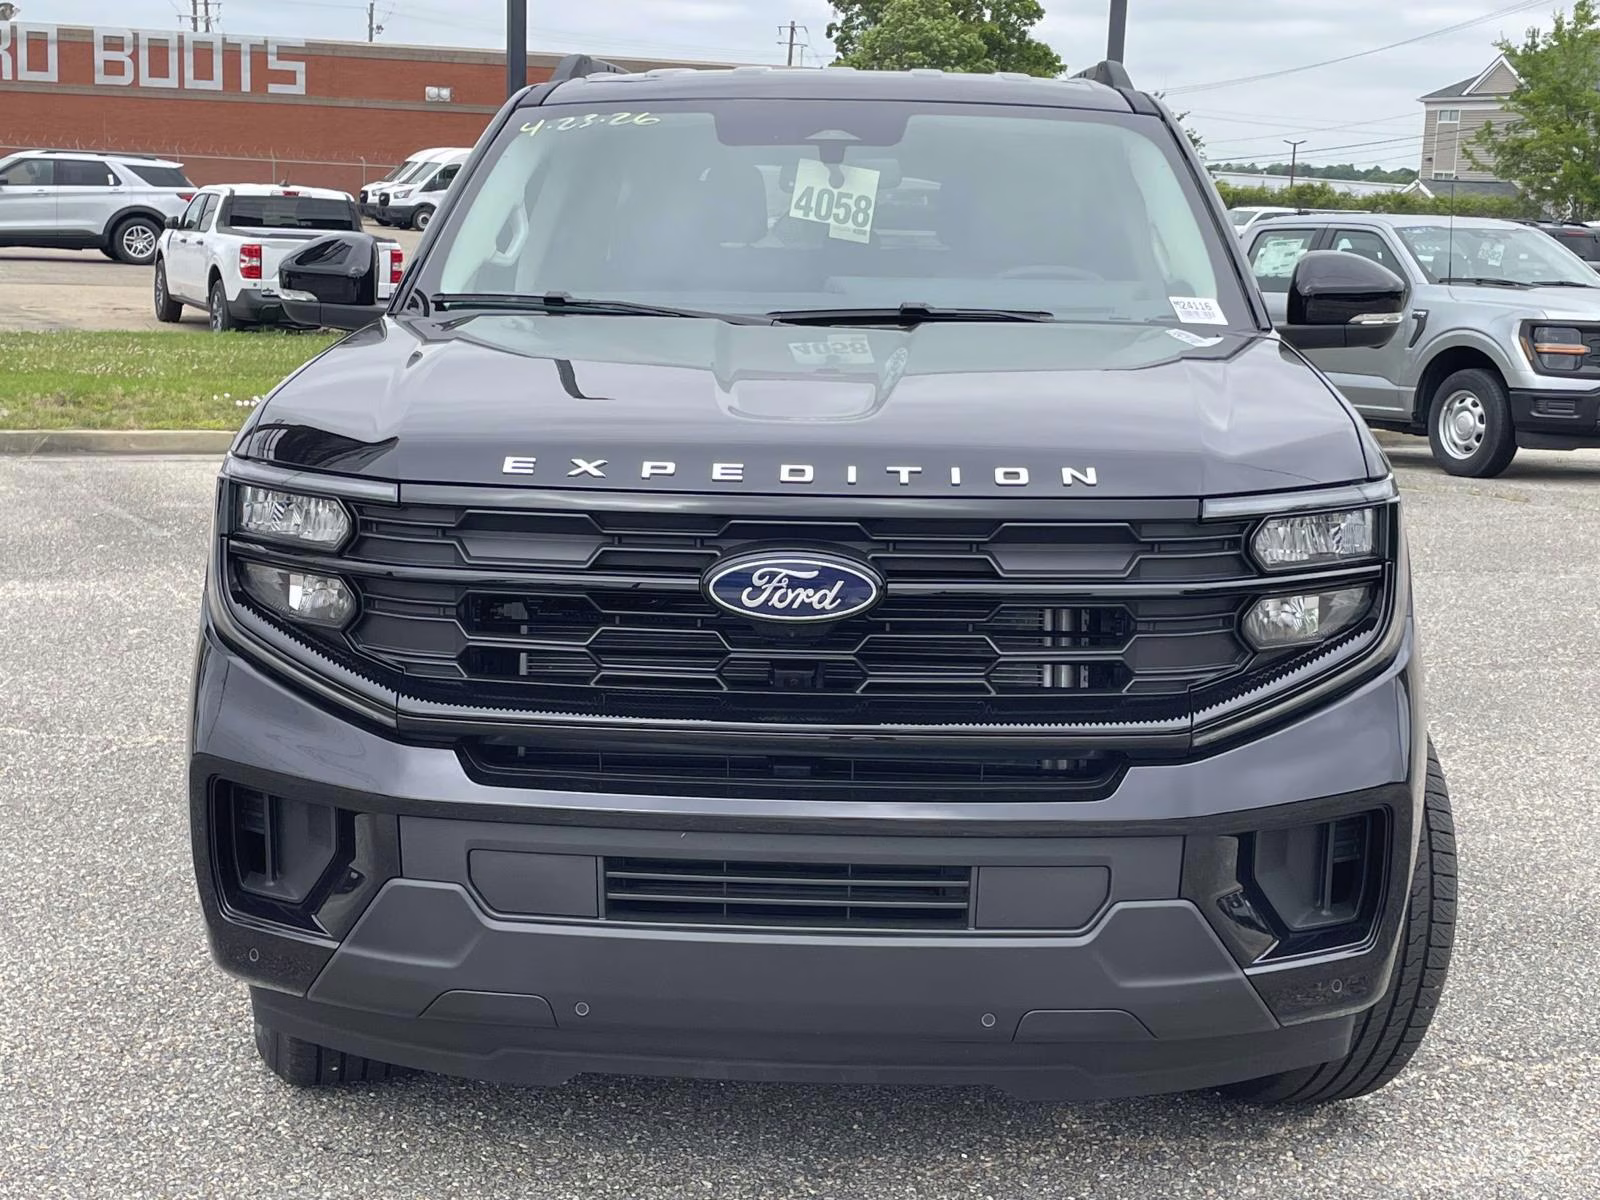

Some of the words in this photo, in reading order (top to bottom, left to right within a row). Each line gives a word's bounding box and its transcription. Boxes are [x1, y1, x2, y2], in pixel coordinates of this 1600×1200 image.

[93, 26, 306, 95] BOOTS
[794, 186, 873, 228] 4058
[502, 455, 1098, 487] EXPEDITION
[741, 567, 845, 610] Ford
